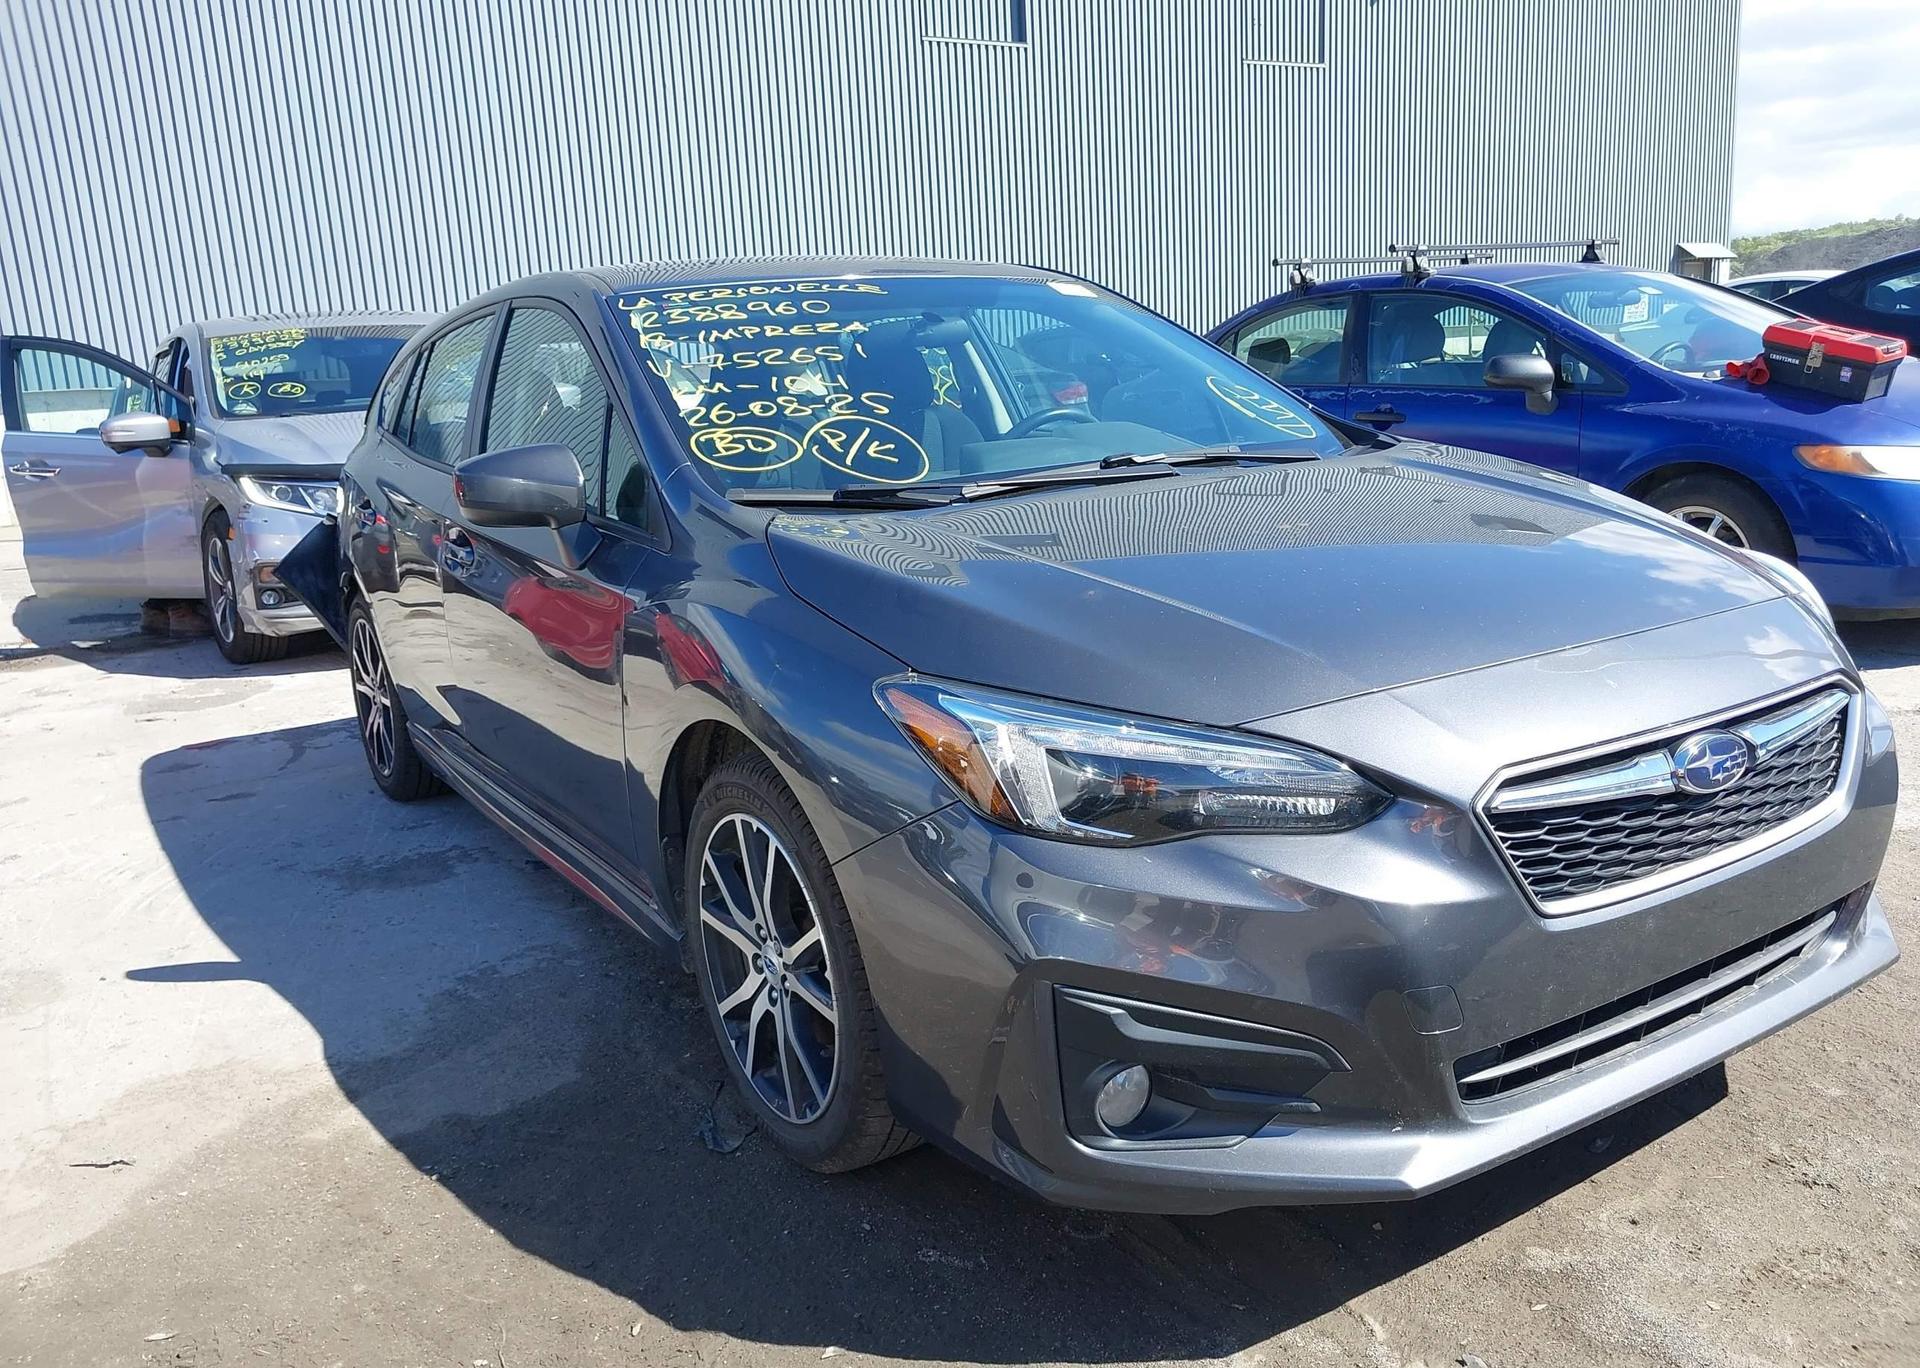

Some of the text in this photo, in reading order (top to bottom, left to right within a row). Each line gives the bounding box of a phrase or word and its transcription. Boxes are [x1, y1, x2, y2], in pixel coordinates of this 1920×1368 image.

[618, 297, 655, 310] LA
[1769, 353, 1800, 365] CRAFTSMAN
[239, 383, 257, 395] K
[716, 786, 762, 811] MICHELIN
